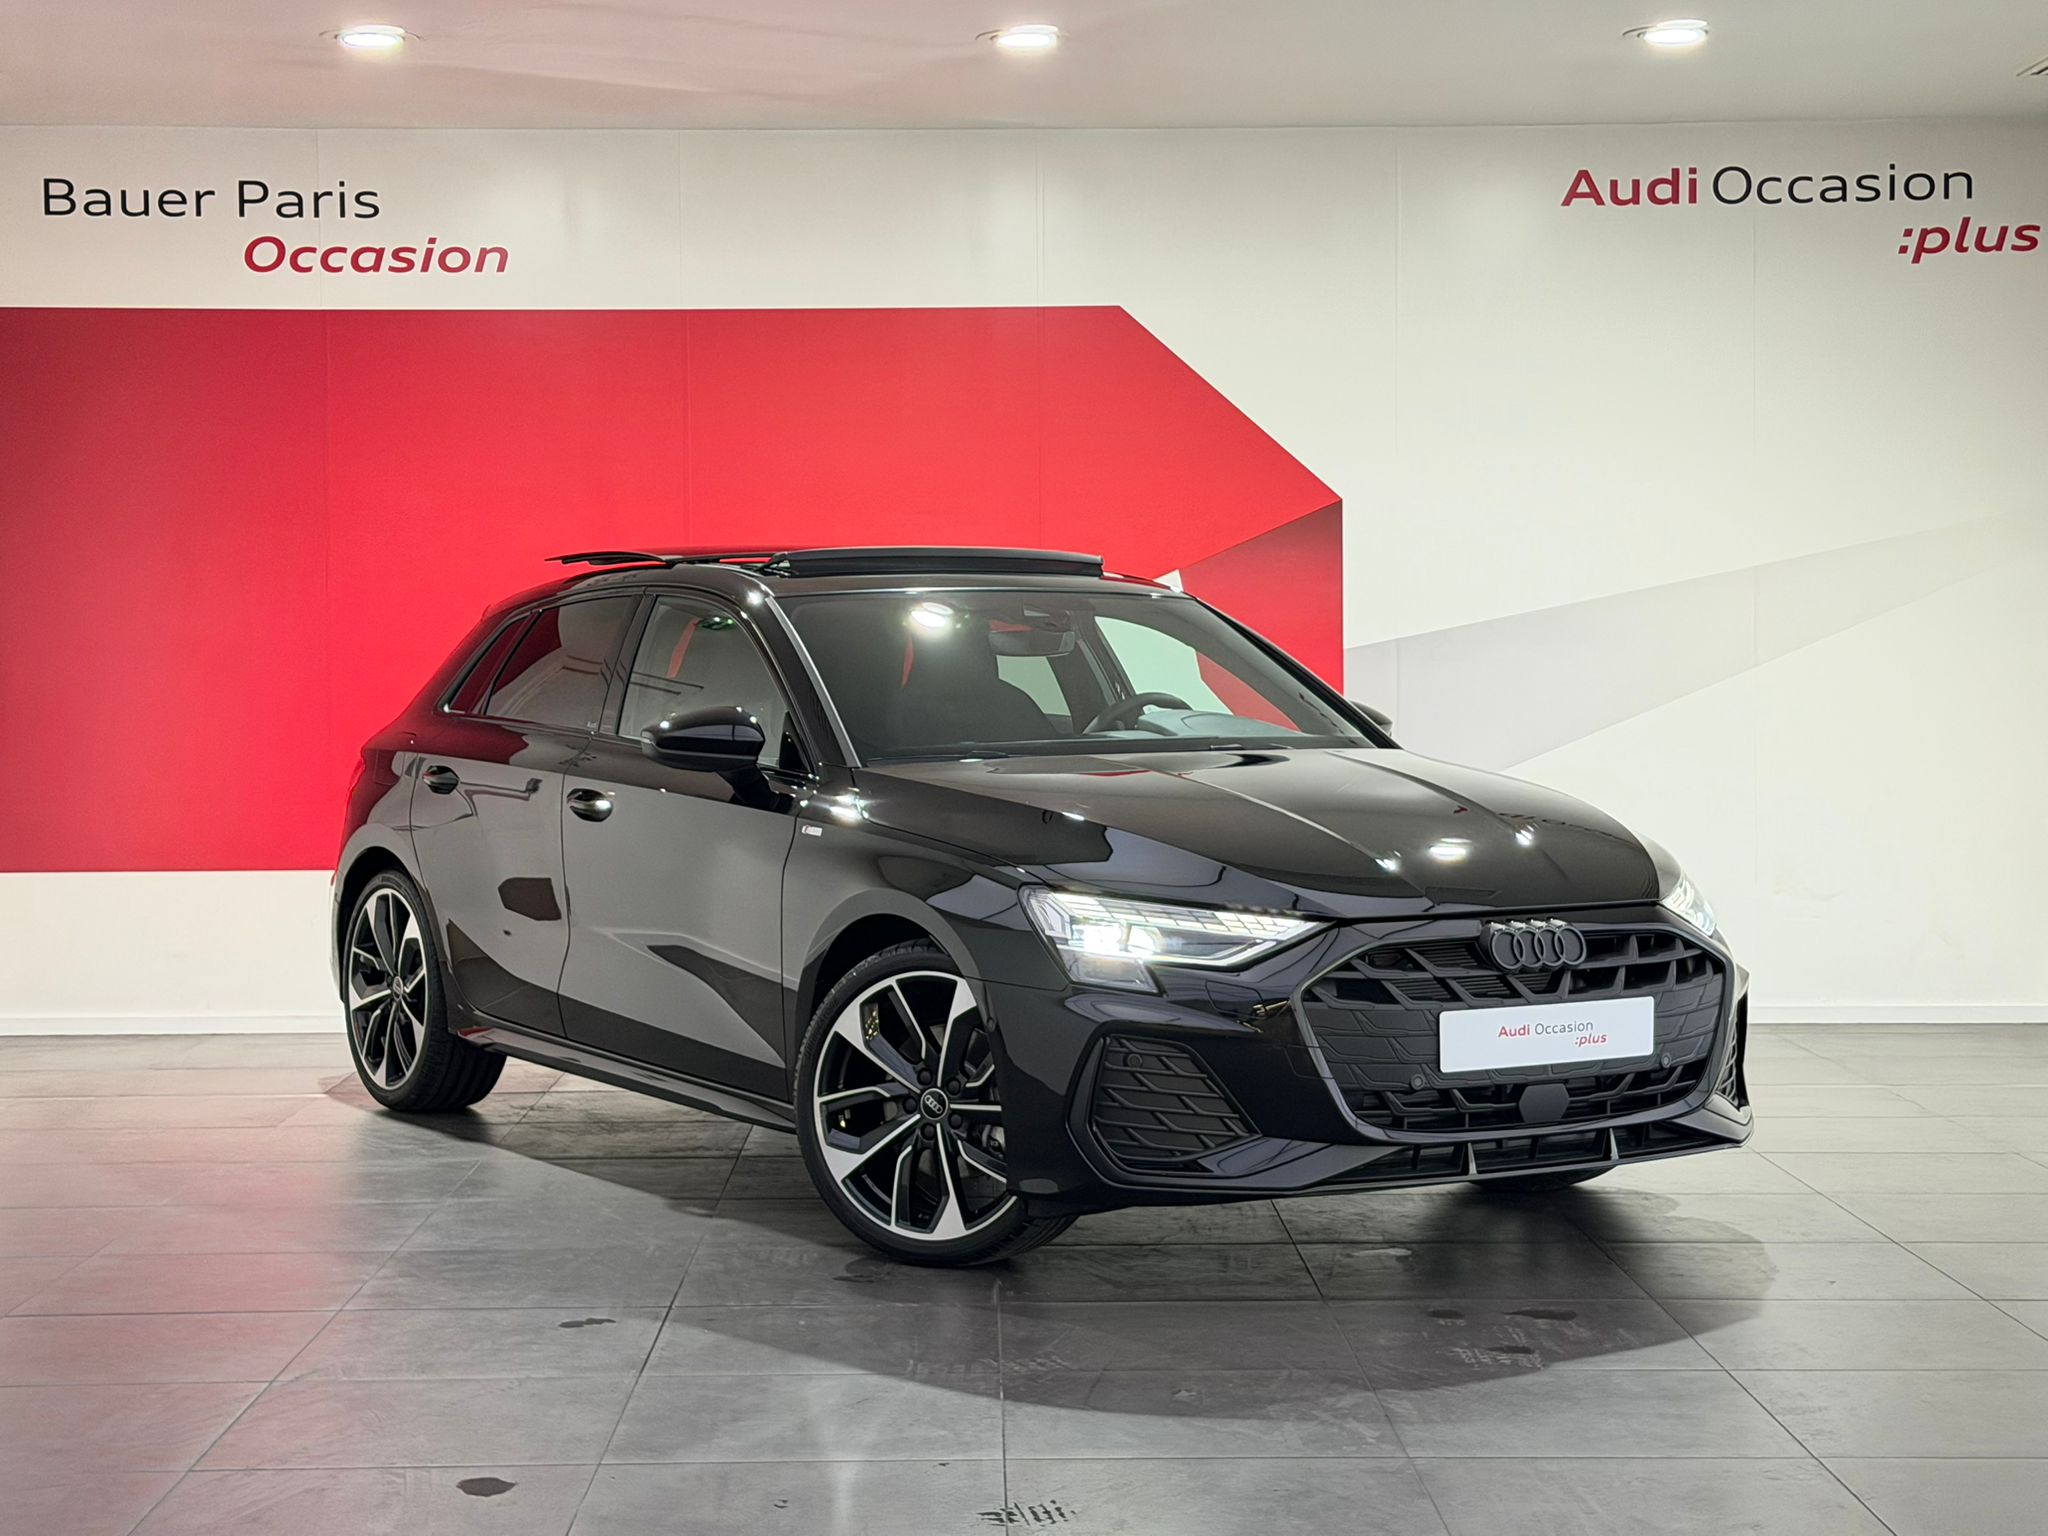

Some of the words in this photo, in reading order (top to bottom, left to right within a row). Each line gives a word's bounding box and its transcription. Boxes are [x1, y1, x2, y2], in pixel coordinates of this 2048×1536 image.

[43, 178, 215, 217] Bauer
[239, 180, 380, 218] Paris
[1561, 168, 1697, 206] Audi
[1712, 163, 1972, 204] Occasion
[243, 236, 508, 273] Occasion
[1898, 217, 2041, 264] :plus
[1498, 1024, 1530, 1037] Audi
[1534, 1021, 1593, 1035] Occasion
[1575, 1033, 1607, 1047] :plus
